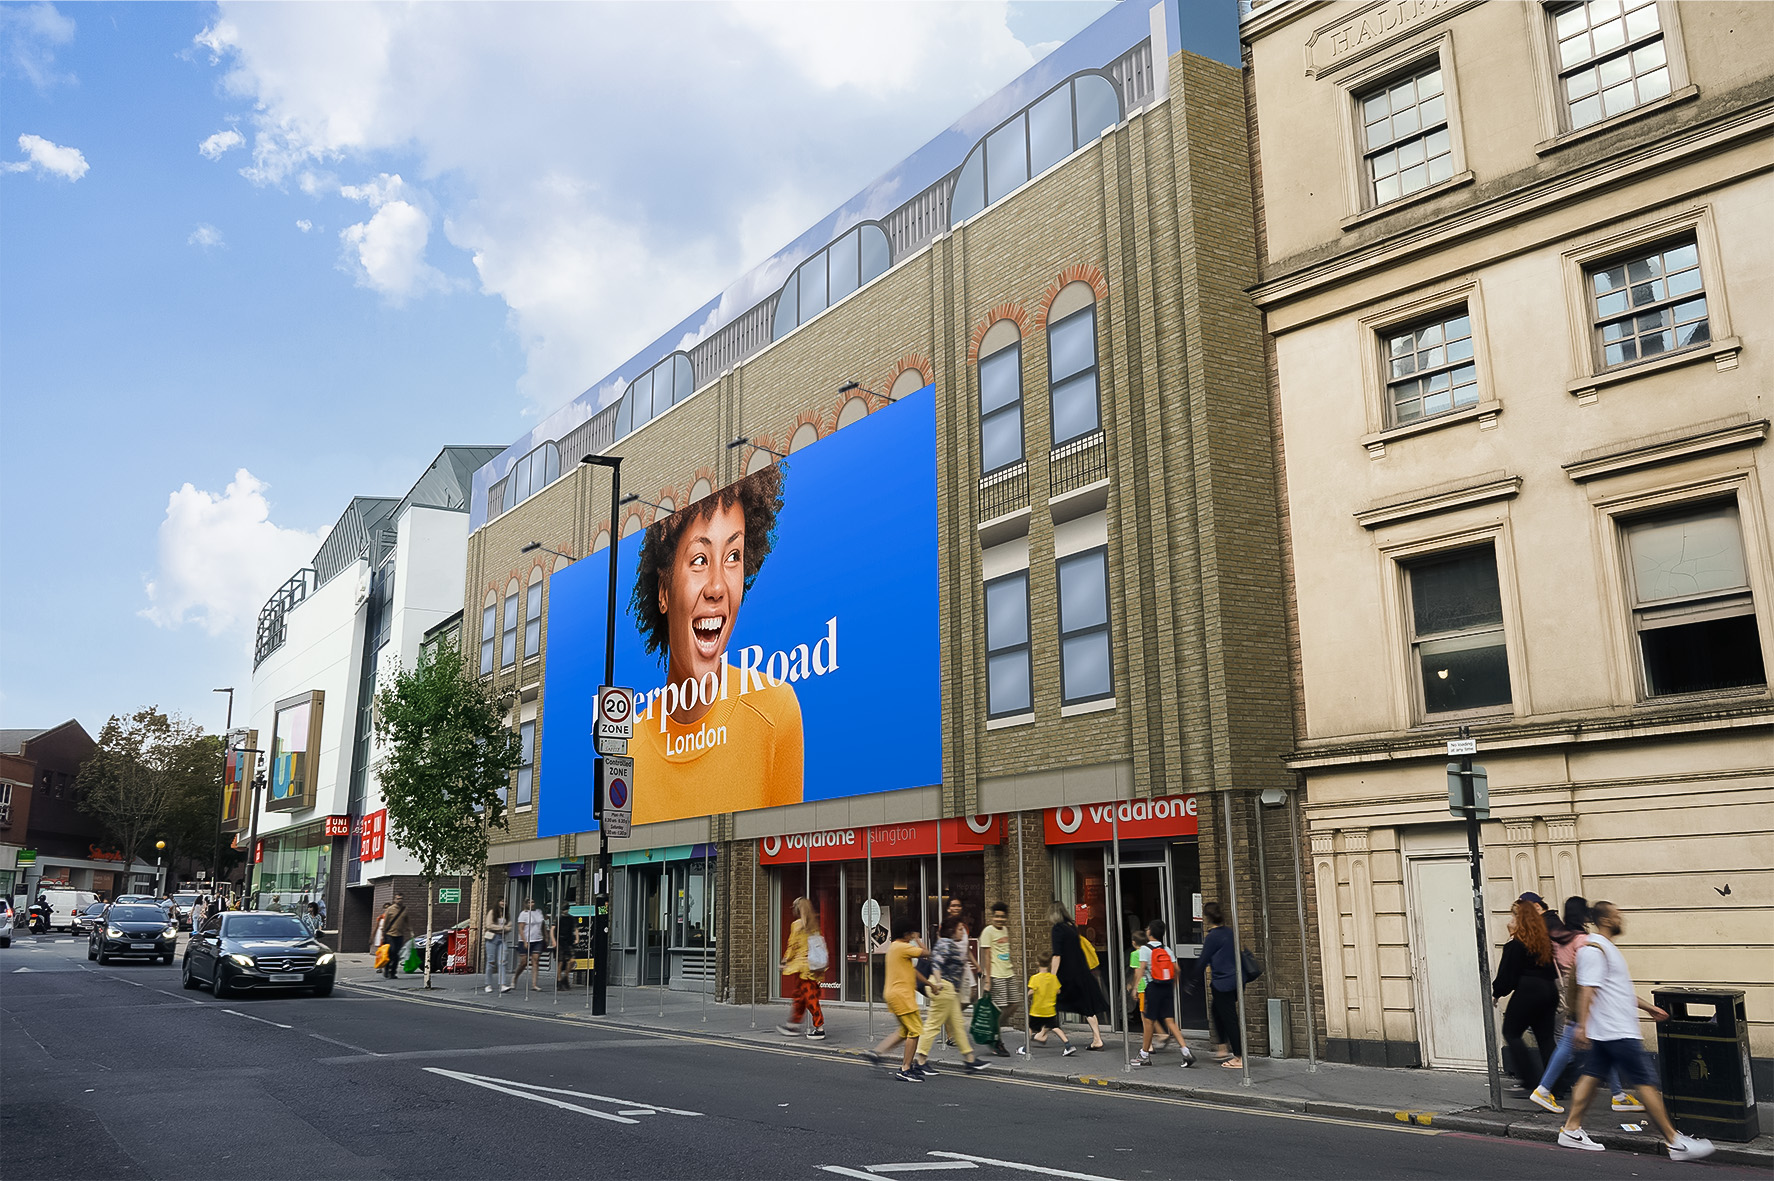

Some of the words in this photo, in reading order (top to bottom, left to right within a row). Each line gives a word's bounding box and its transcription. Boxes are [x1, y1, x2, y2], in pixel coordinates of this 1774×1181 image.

[590, 651, 729, 735] erpool
[738, 615, 840, 697] Road
[606, 699, 627, 713] 20
[601, 724, 629, 734] ZONE
[666, 723, 727, 756] London
[605, 758, 632, 767] Controlled
[609, 767, 628, 777] ZONE
[332, 818, 347, 826] UNI
[331, 826, 348, 834] QLO
[870, 826, 916, 846] slington
